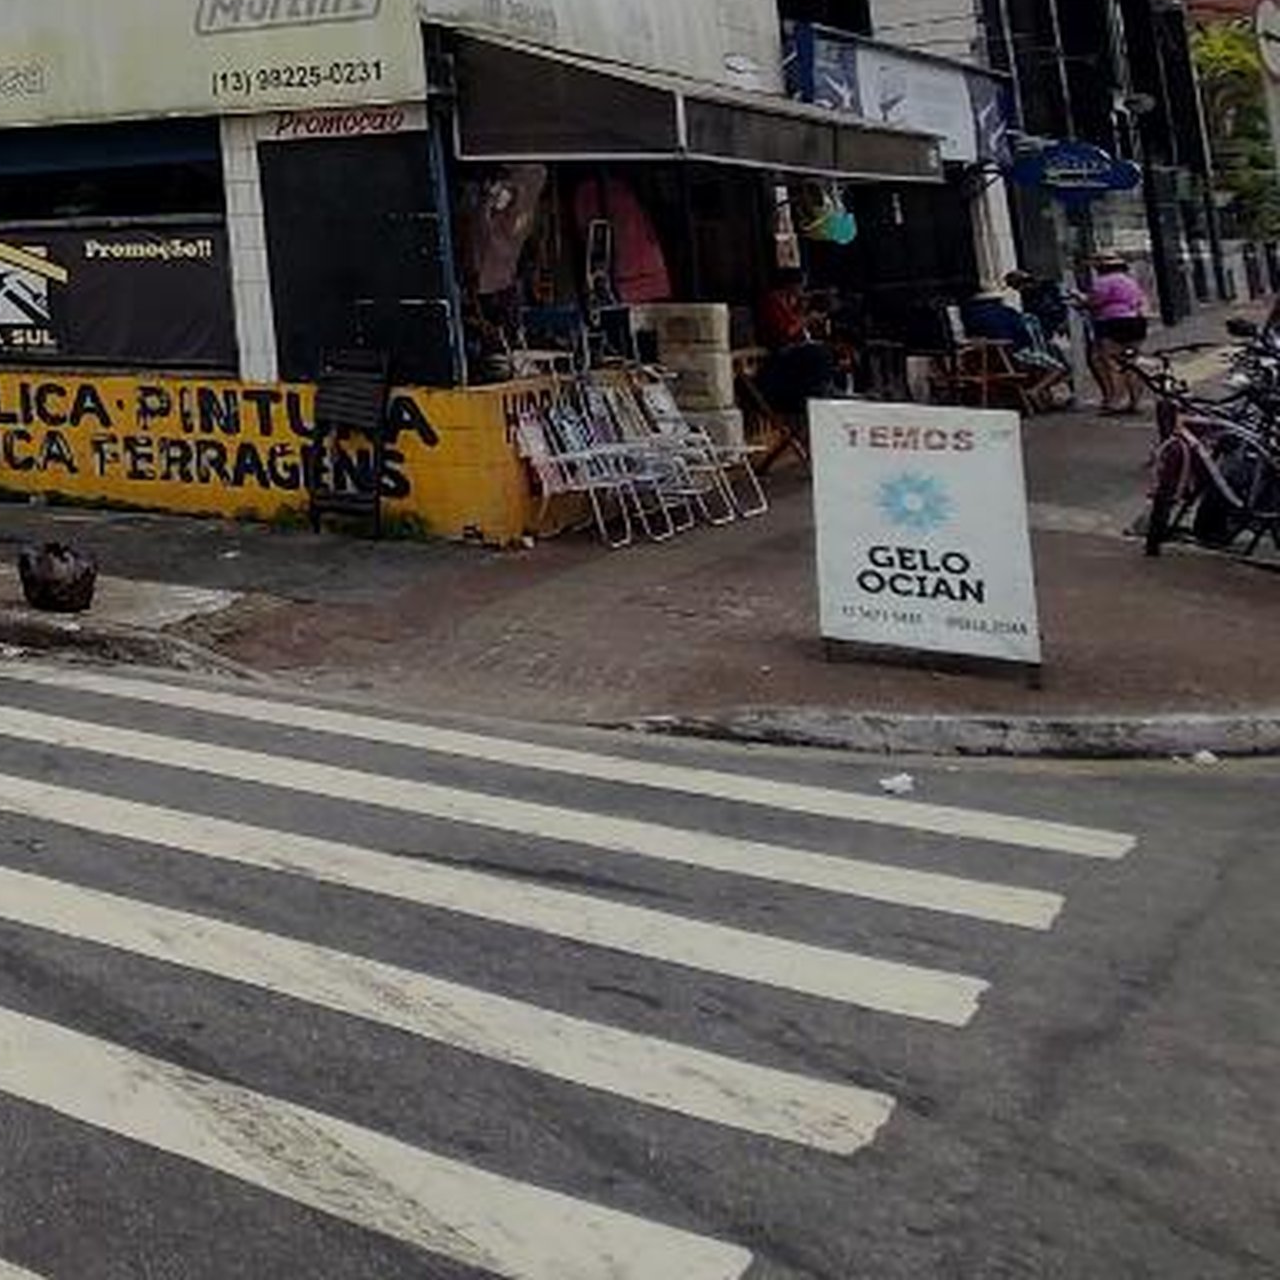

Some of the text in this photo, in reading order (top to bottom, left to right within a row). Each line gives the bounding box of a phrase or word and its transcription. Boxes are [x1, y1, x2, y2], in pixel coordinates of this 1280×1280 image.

[212, 70, 252, 96] (13)
[85, 239, 212, 261] Promoção!!
[10, 328, 57, 345] SUL
[137, 386, 438, 445] PINTUA
[843, 422, 976, 452] TEMOS
[92, 434, 411, 498] FERRAGENS
[867, 544, 971, 575] GELO
[856, 569, 986, 604] OCIAN
